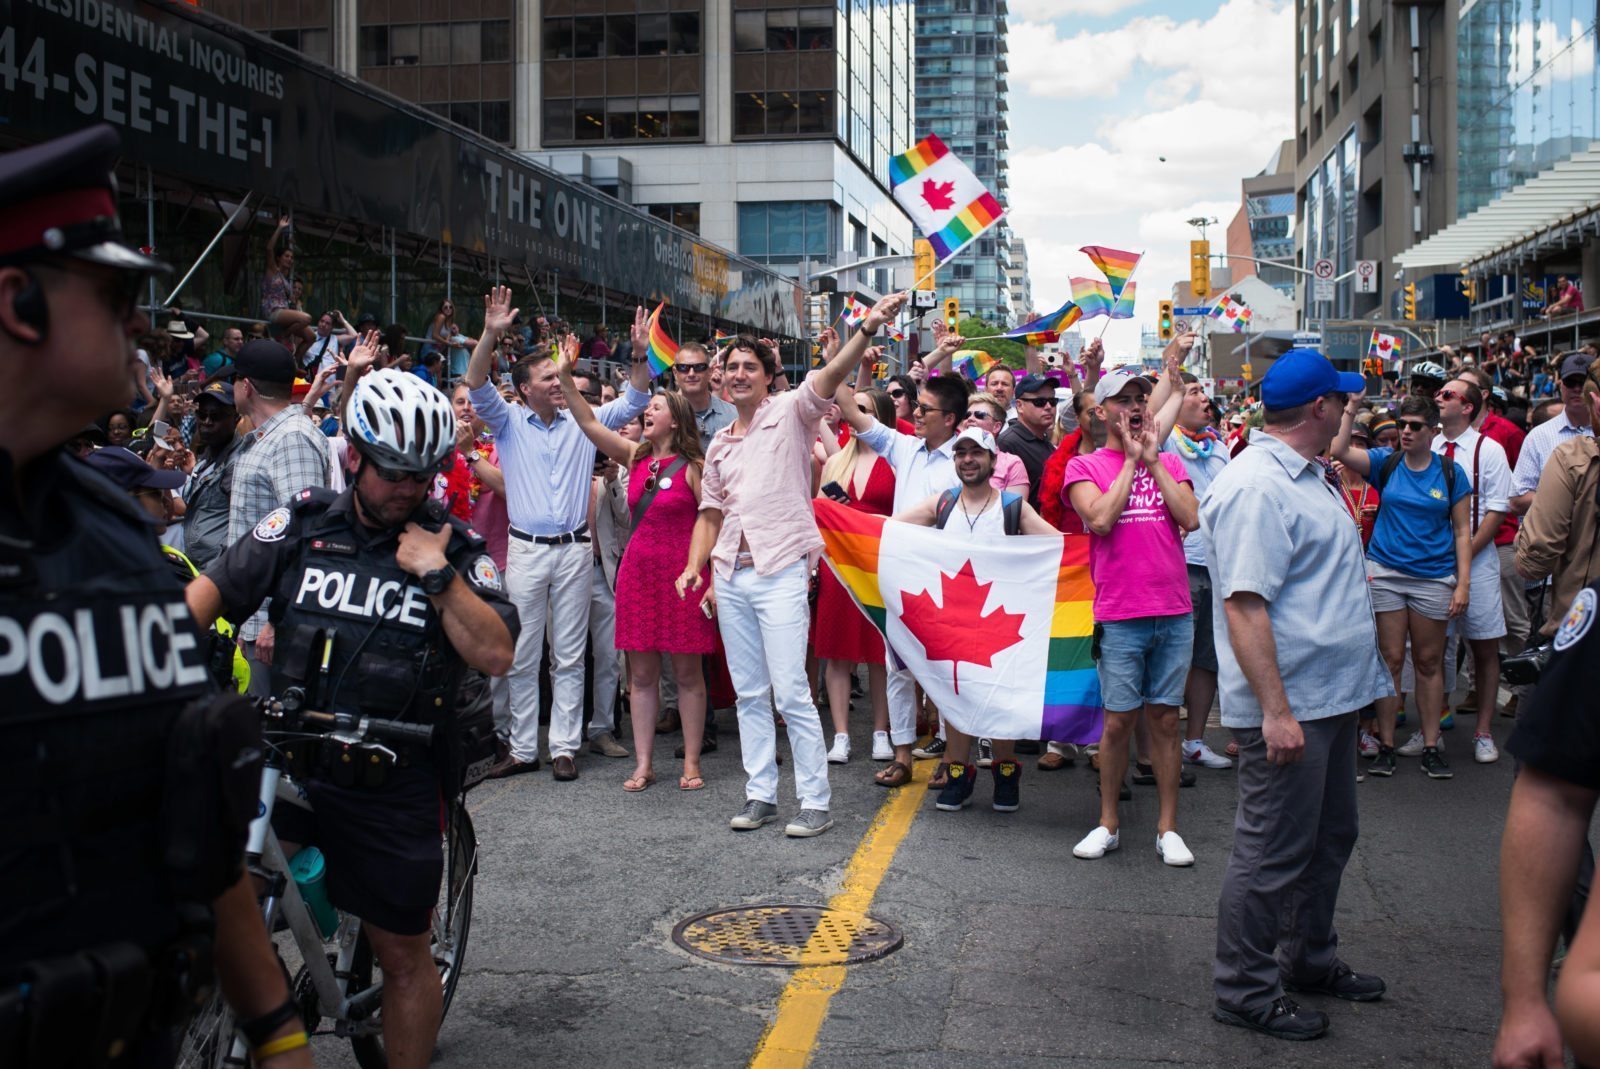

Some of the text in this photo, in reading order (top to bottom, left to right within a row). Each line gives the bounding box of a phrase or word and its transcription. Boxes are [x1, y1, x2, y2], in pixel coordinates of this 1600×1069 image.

[25, 0, 284, 99] SIDENTIAL INQUIRIES
[484, 224, 520, 248] RETAIL
[525, 238, 543, 255] AND
[485, 159, 601, 250] THE ONE
[296, 567, 428, 628] POLICE
[0, 603, 208, 704] POLICE
